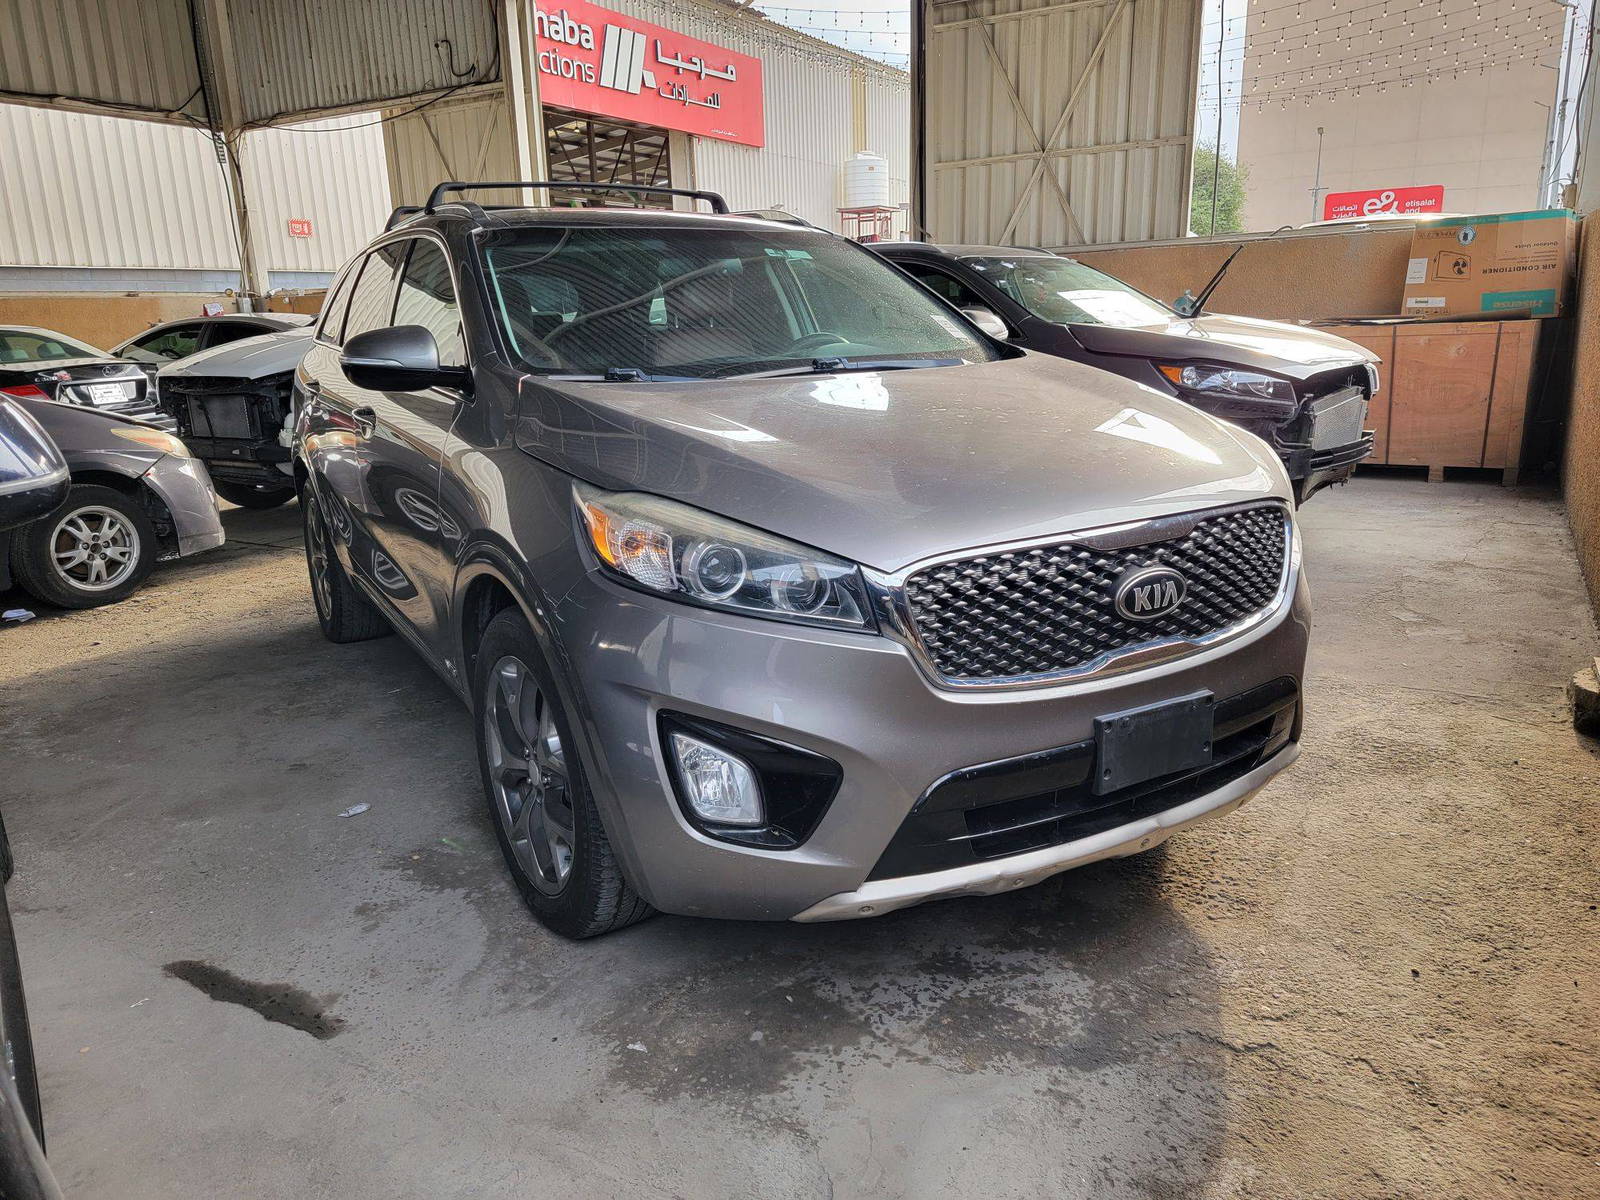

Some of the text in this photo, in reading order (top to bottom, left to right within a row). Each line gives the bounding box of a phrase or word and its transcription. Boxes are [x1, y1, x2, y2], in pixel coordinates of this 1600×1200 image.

[538, 48, 595, 84] ctions
[655, 39, 736, 82] مرحبا
[1405, 198, 1436, 208] etisalat
[1482, 264, 1539, 274] CONDITIONER
[1133, 581, 1178, 613] KIA
